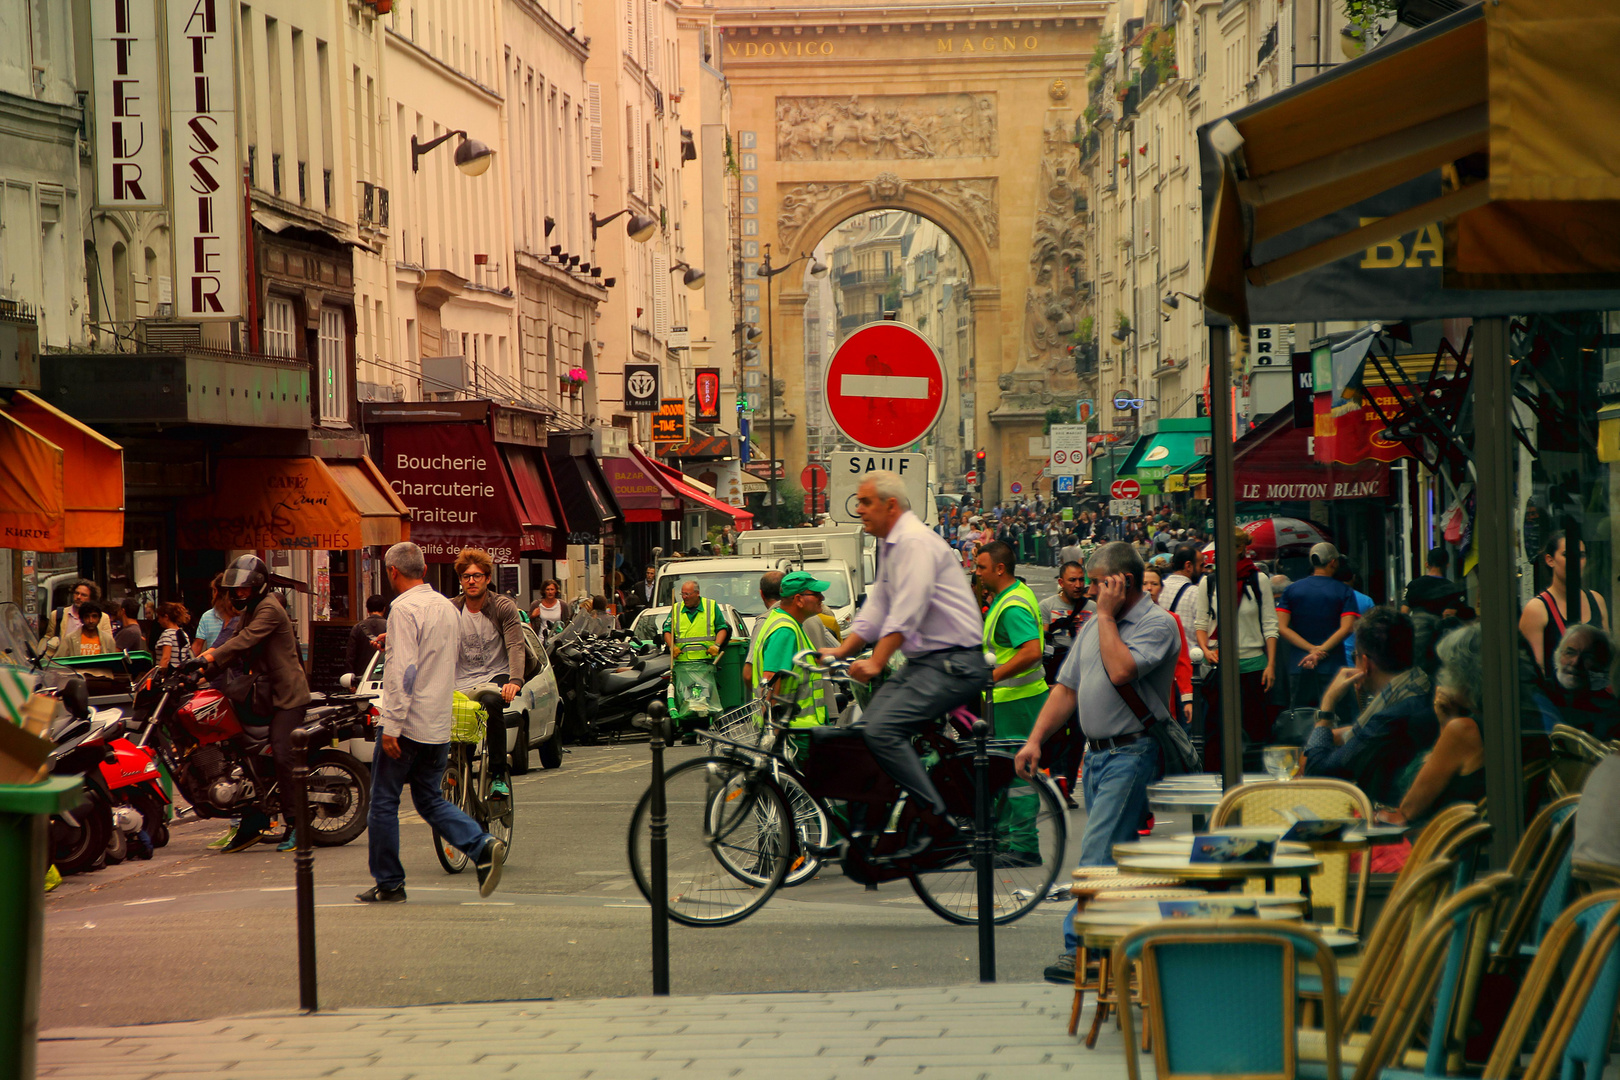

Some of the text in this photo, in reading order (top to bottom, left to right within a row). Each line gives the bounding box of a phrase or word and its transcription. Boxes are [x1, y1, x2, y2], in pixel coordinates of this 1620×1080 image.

[728, 36, 1039, 57] VDOVICO MAGNO
[184, 0, 225, 313] ATISSIER
[744, 132, 758, 277] PASSAGE
[653, 404, 684, 416] NDOORI
[658, 419, 676, 432] TIME
[397, 454, 487, 471] Boucherie
[850, 457, 910, 475] SAUF
[615, 472, 644, 480] BAZAR
[389, 480, 495, 497] Charcuterie
[615, 485, 659, 494] COULEURS
[1243, 481, 1380, 498] LE MOUTON BLANC
[408, 507, 478, 522] Traiteur
[5, 527, 51, 539] KURDE
[315, 529, 350, 548] THÉS
[446, 544, 460, 555] de
[487, 547, 512, 559] gras
